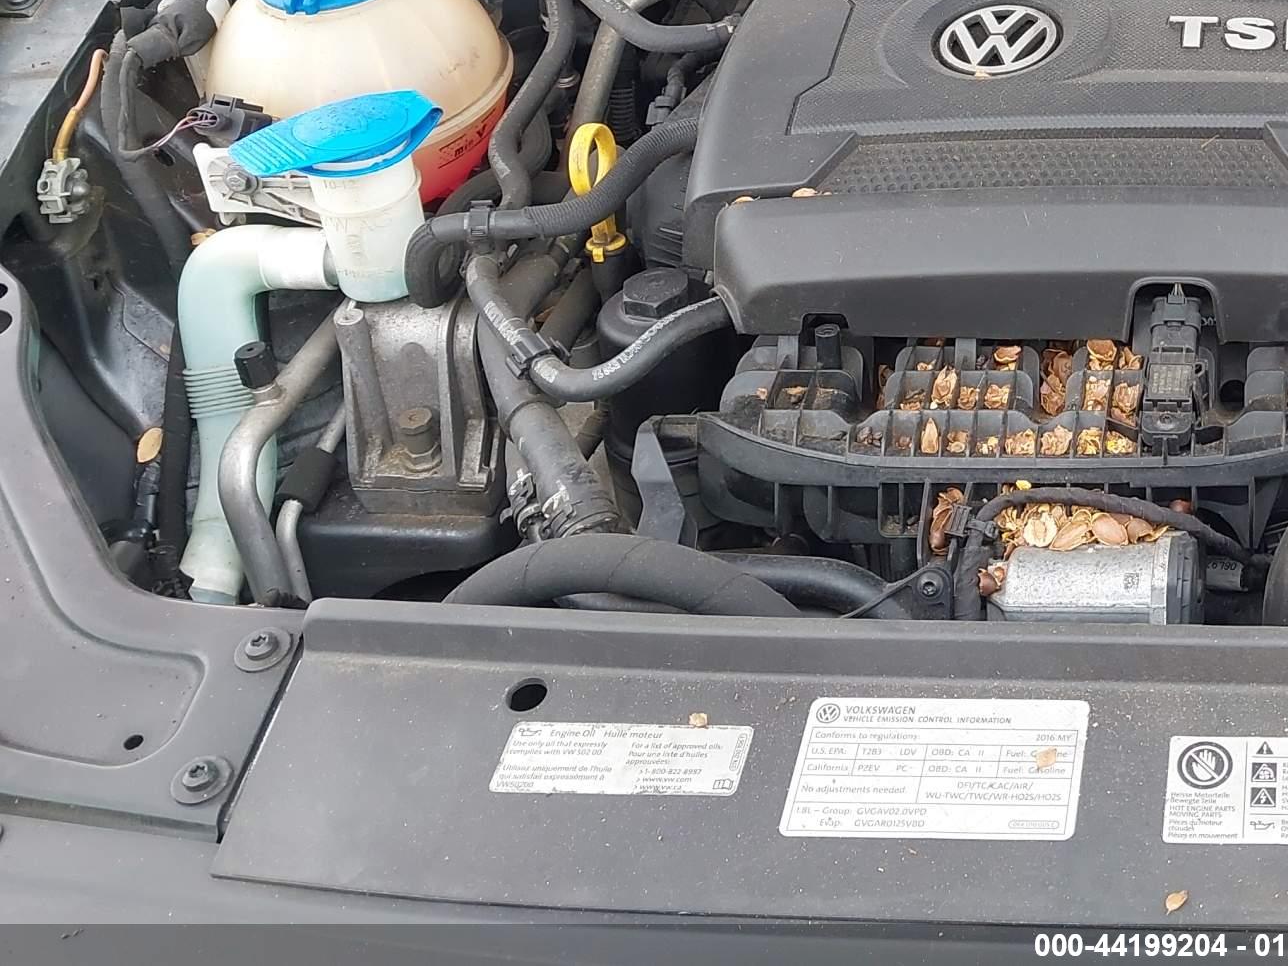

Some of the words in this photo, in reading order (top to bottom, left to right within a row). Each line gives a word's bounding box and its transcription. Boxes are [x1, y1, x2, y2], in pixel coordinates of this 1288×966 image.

[846, 706, 916, 715] VOLKSWAGEN
[843, 715, 874, 723] VEHICLE
[550, 729, 582, 739] Engine
[629, 731, 663, 739] moteur
[815, 730, 857, 739] Conforms
[1036, 733, 1056, 741] 2016
[528, 740, 543, 749] only
[573, 741, 608, 750] expressly
[672, 743, 707, 751] approved
[509, 749, 542, 757] complies
[899, 748, 917, 756] LDV
[931, 748, 954, 756] OBD:
[958, 749, 971, 757] CA
[531, 765, 577, 774] uniquement
[896, 764, 908, 772] PC
[928, 765, 952, 773] OBD:
[955, 765, 968, 773] CA
[1028, 767, 1067, 775] Gasoline
[498, 773, 511, 782] qui
[800, 785, 815, 793] No
[815, 785, 871, 795] adjustments
